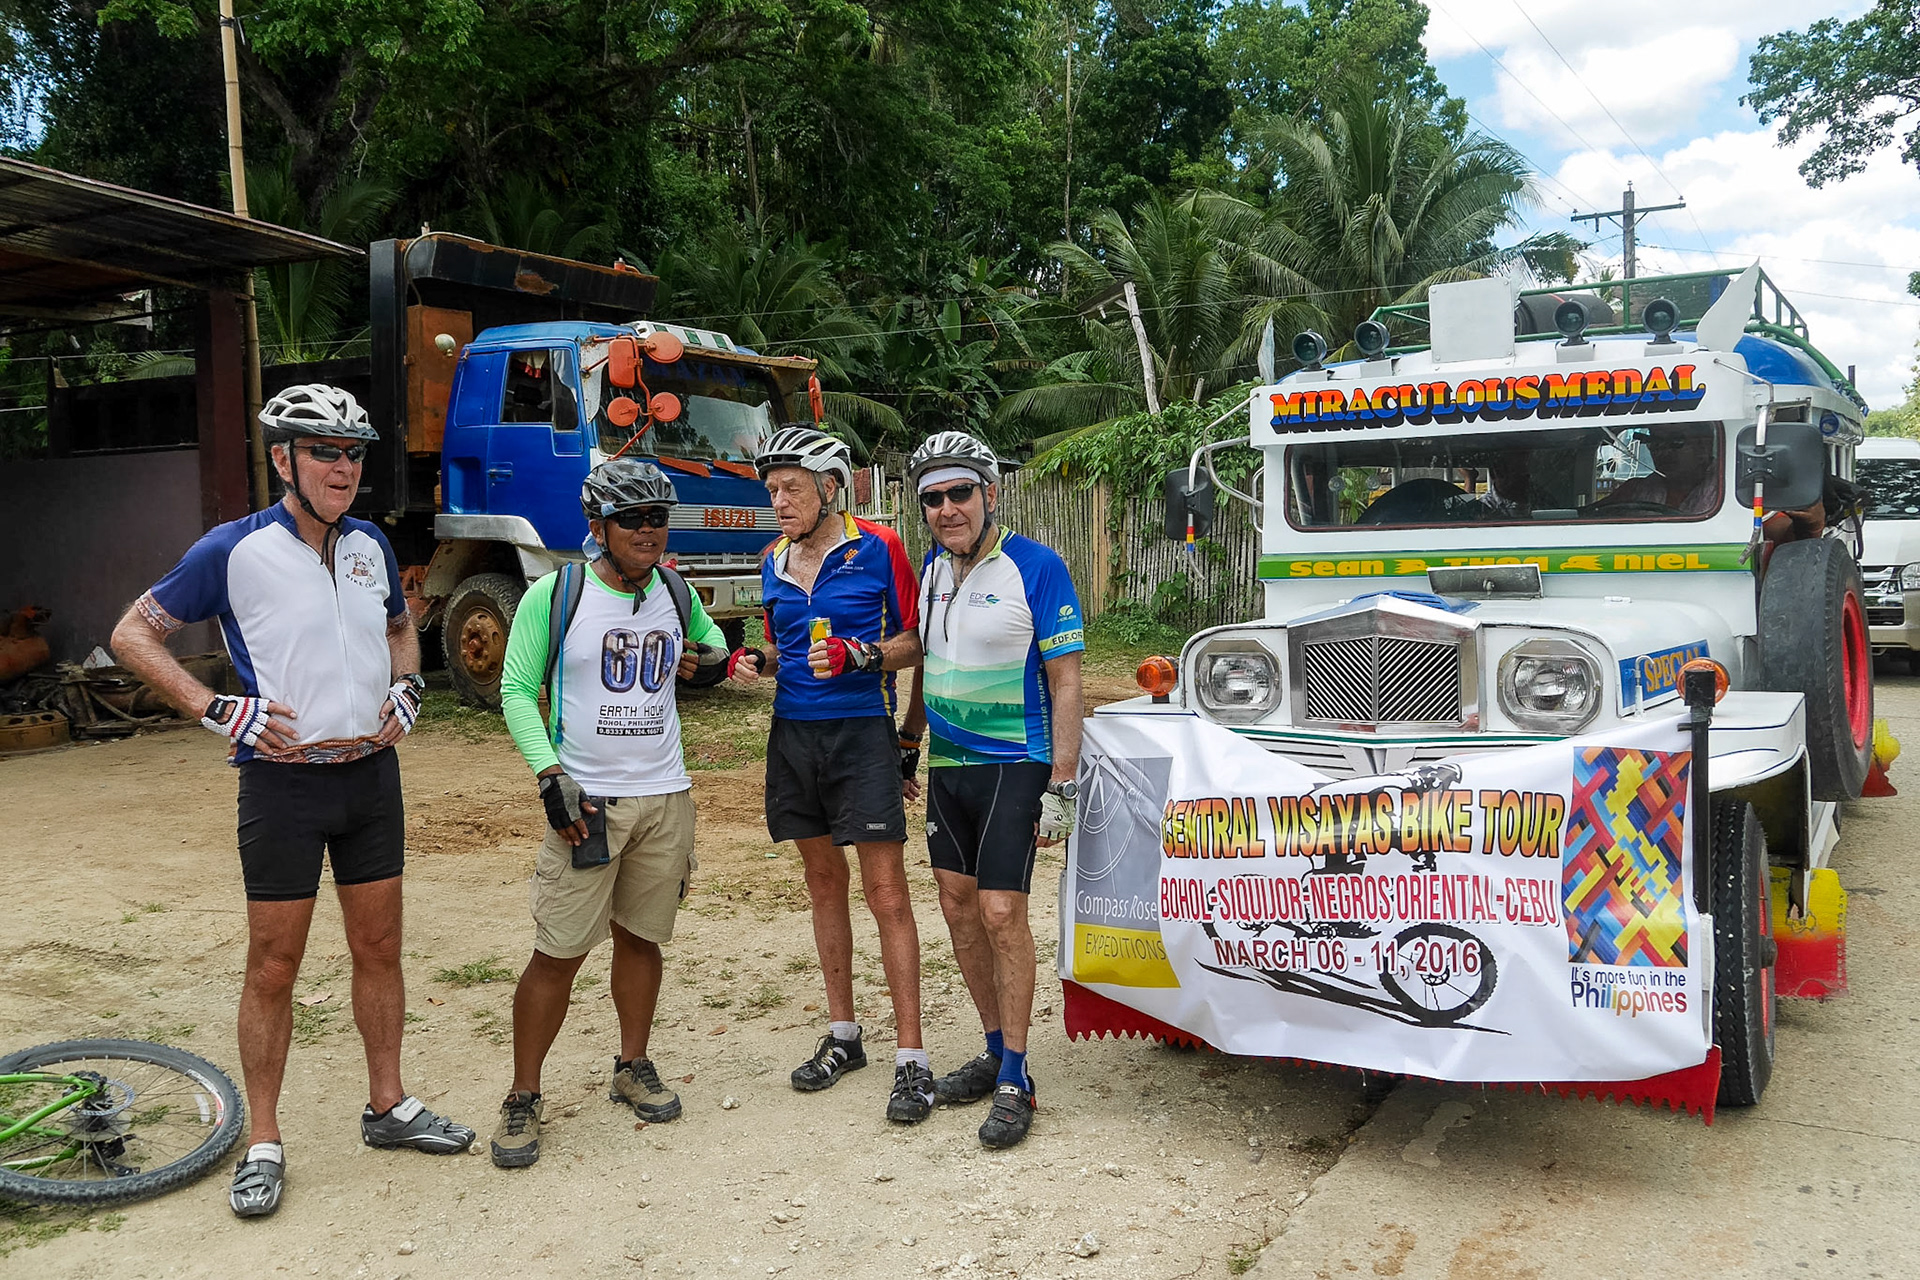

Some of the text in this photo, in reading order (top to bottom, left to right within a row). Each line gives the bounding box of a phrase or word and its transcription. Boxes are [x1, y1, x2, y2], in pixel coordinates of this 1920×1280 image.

[1270, 365, 1707, 432] MIRACULOUS MEDAL
[704, 508, 756, 528] ISUZU
[598, 719, 626, 727] BOHOL,
[600, 705, 637, 717] EARTH
[1162, 789, 1565, 859] CENTRAL VISAYAS BIKE TOUR
[1076, 890, 1158, 923] Compass Rose
[1084, 932, 1167, 960] EXPEDITIONS
[1214, 938, 1308, 972] MARCH
[1317, 939, 1345, 971] 06
[1371, 940, 1408, 978] 11,
[1414, 940, 1480, 974] 2016
[1595, 971, 1626, 984] more
[1628, 971, 1647, 986] fun
[1650, 971, 1660, 986] in
[1665, 971, 1686, 986] the
[1571, 981, 1688, 1018] Philippines
